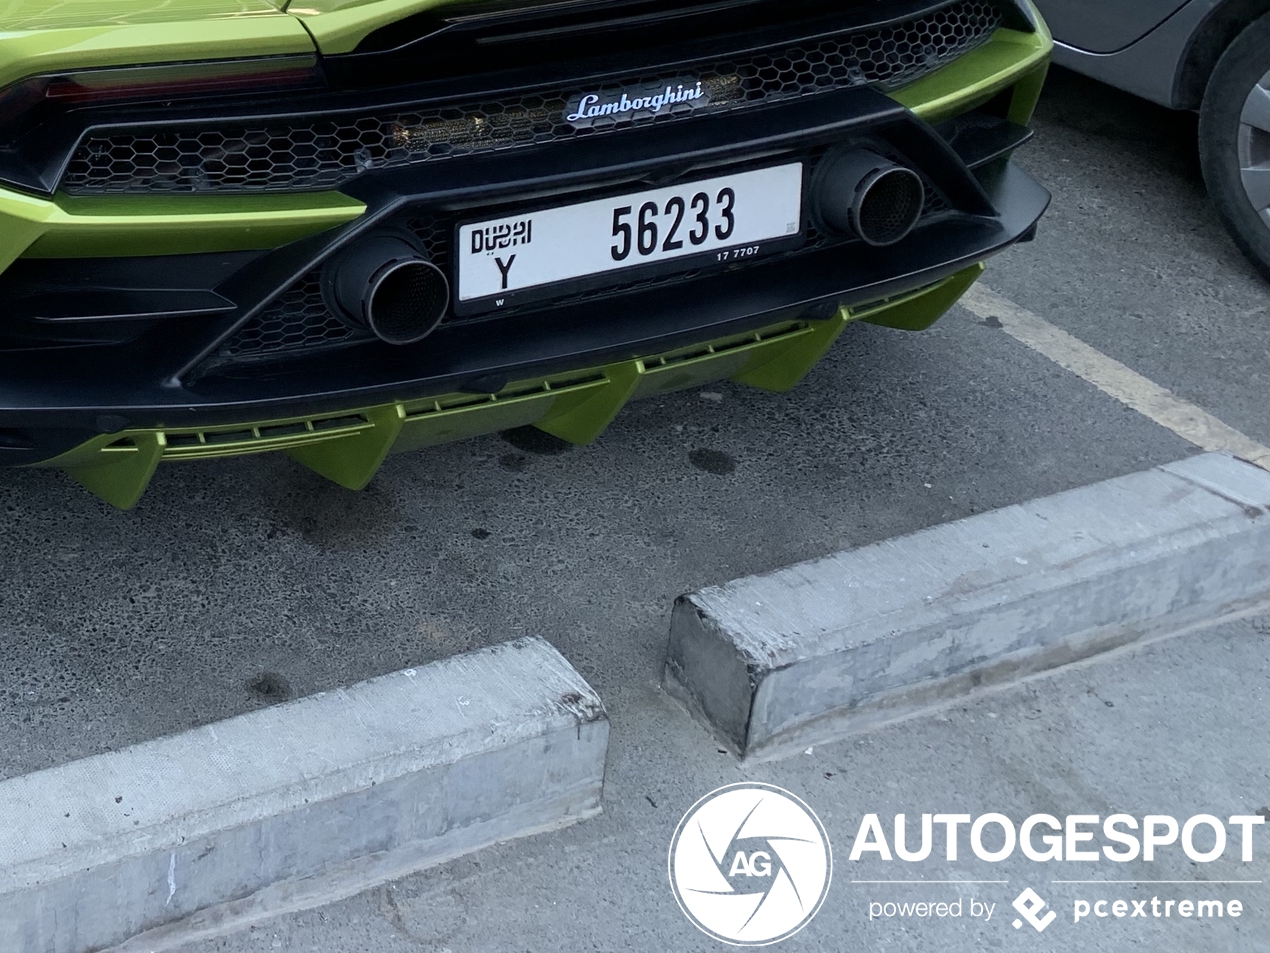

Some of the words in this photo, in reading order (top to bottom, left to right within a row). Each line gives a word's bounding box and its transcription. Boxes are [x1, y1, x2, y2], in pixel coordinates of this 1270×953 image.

[566, 81, 705, 122] Lamborghini
[471, 219, 532, 255] DUBAI
[610, 186, 736, 262] 56233
[733, 246, 760, 260] 7707
[494, 254, 517, 289] Y
